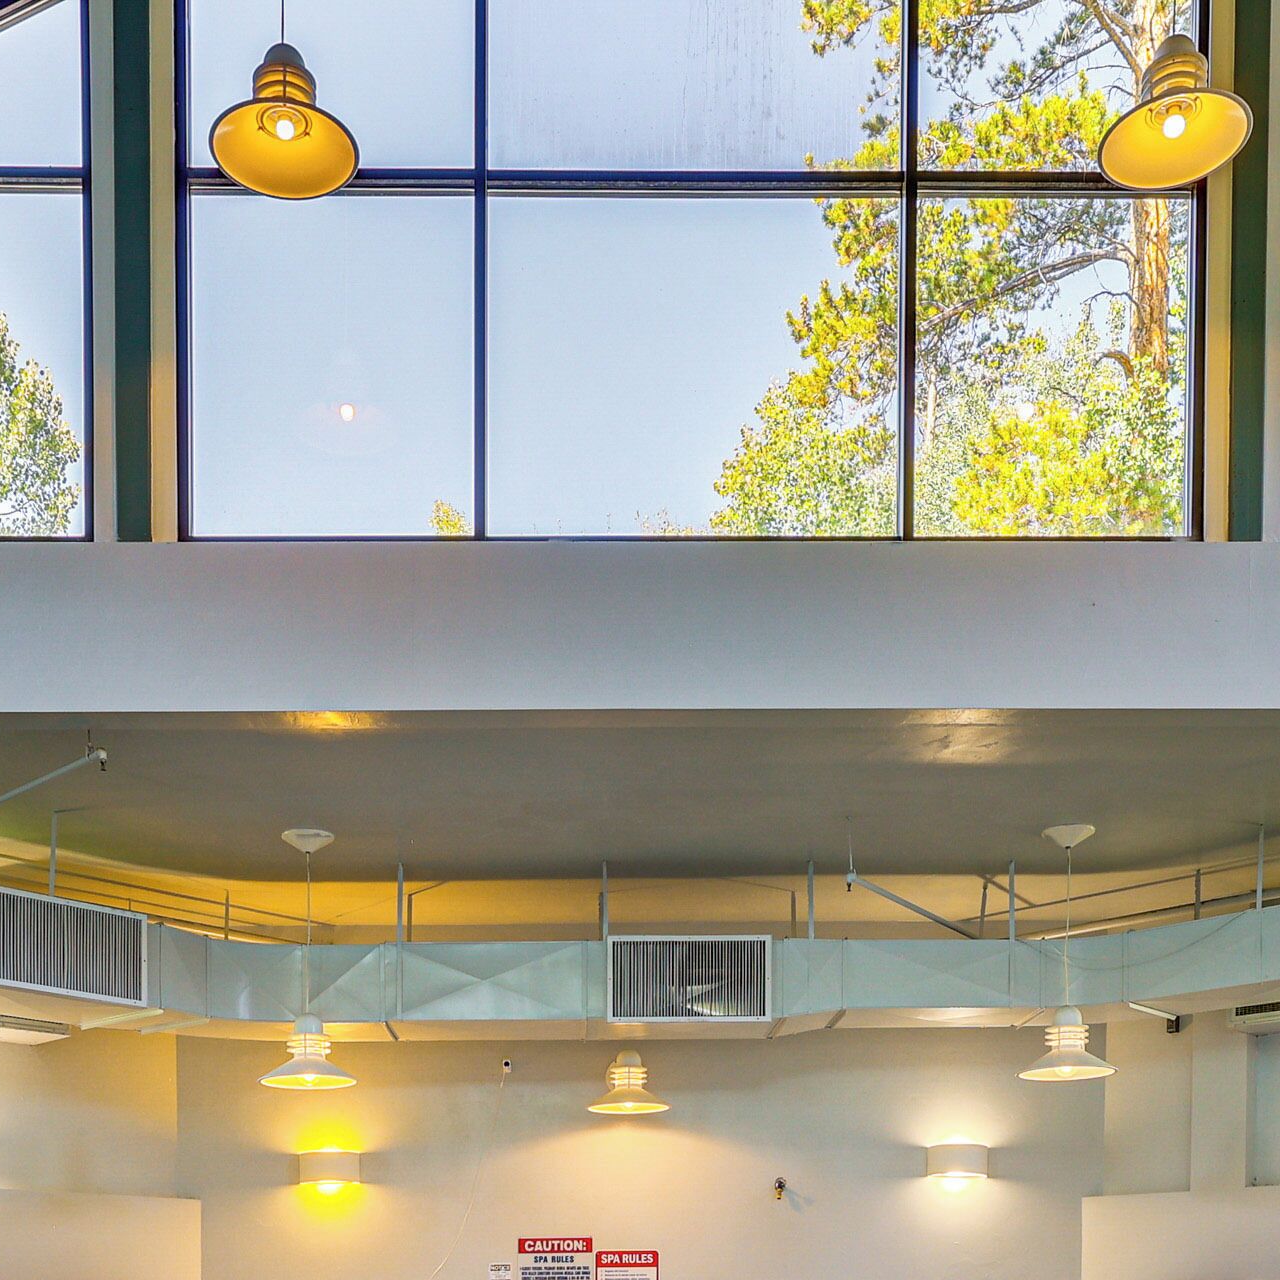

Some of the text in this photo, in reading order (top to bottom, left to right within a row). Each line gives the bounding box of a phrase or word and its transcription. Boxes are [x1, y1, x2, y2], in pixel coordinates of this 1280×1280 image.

[524, 1240, 587, 1251] CAUTION:
[533, 1255, 575, 1264] SPA RULES
[601, 1253, 654, 1264] SPA RULES
